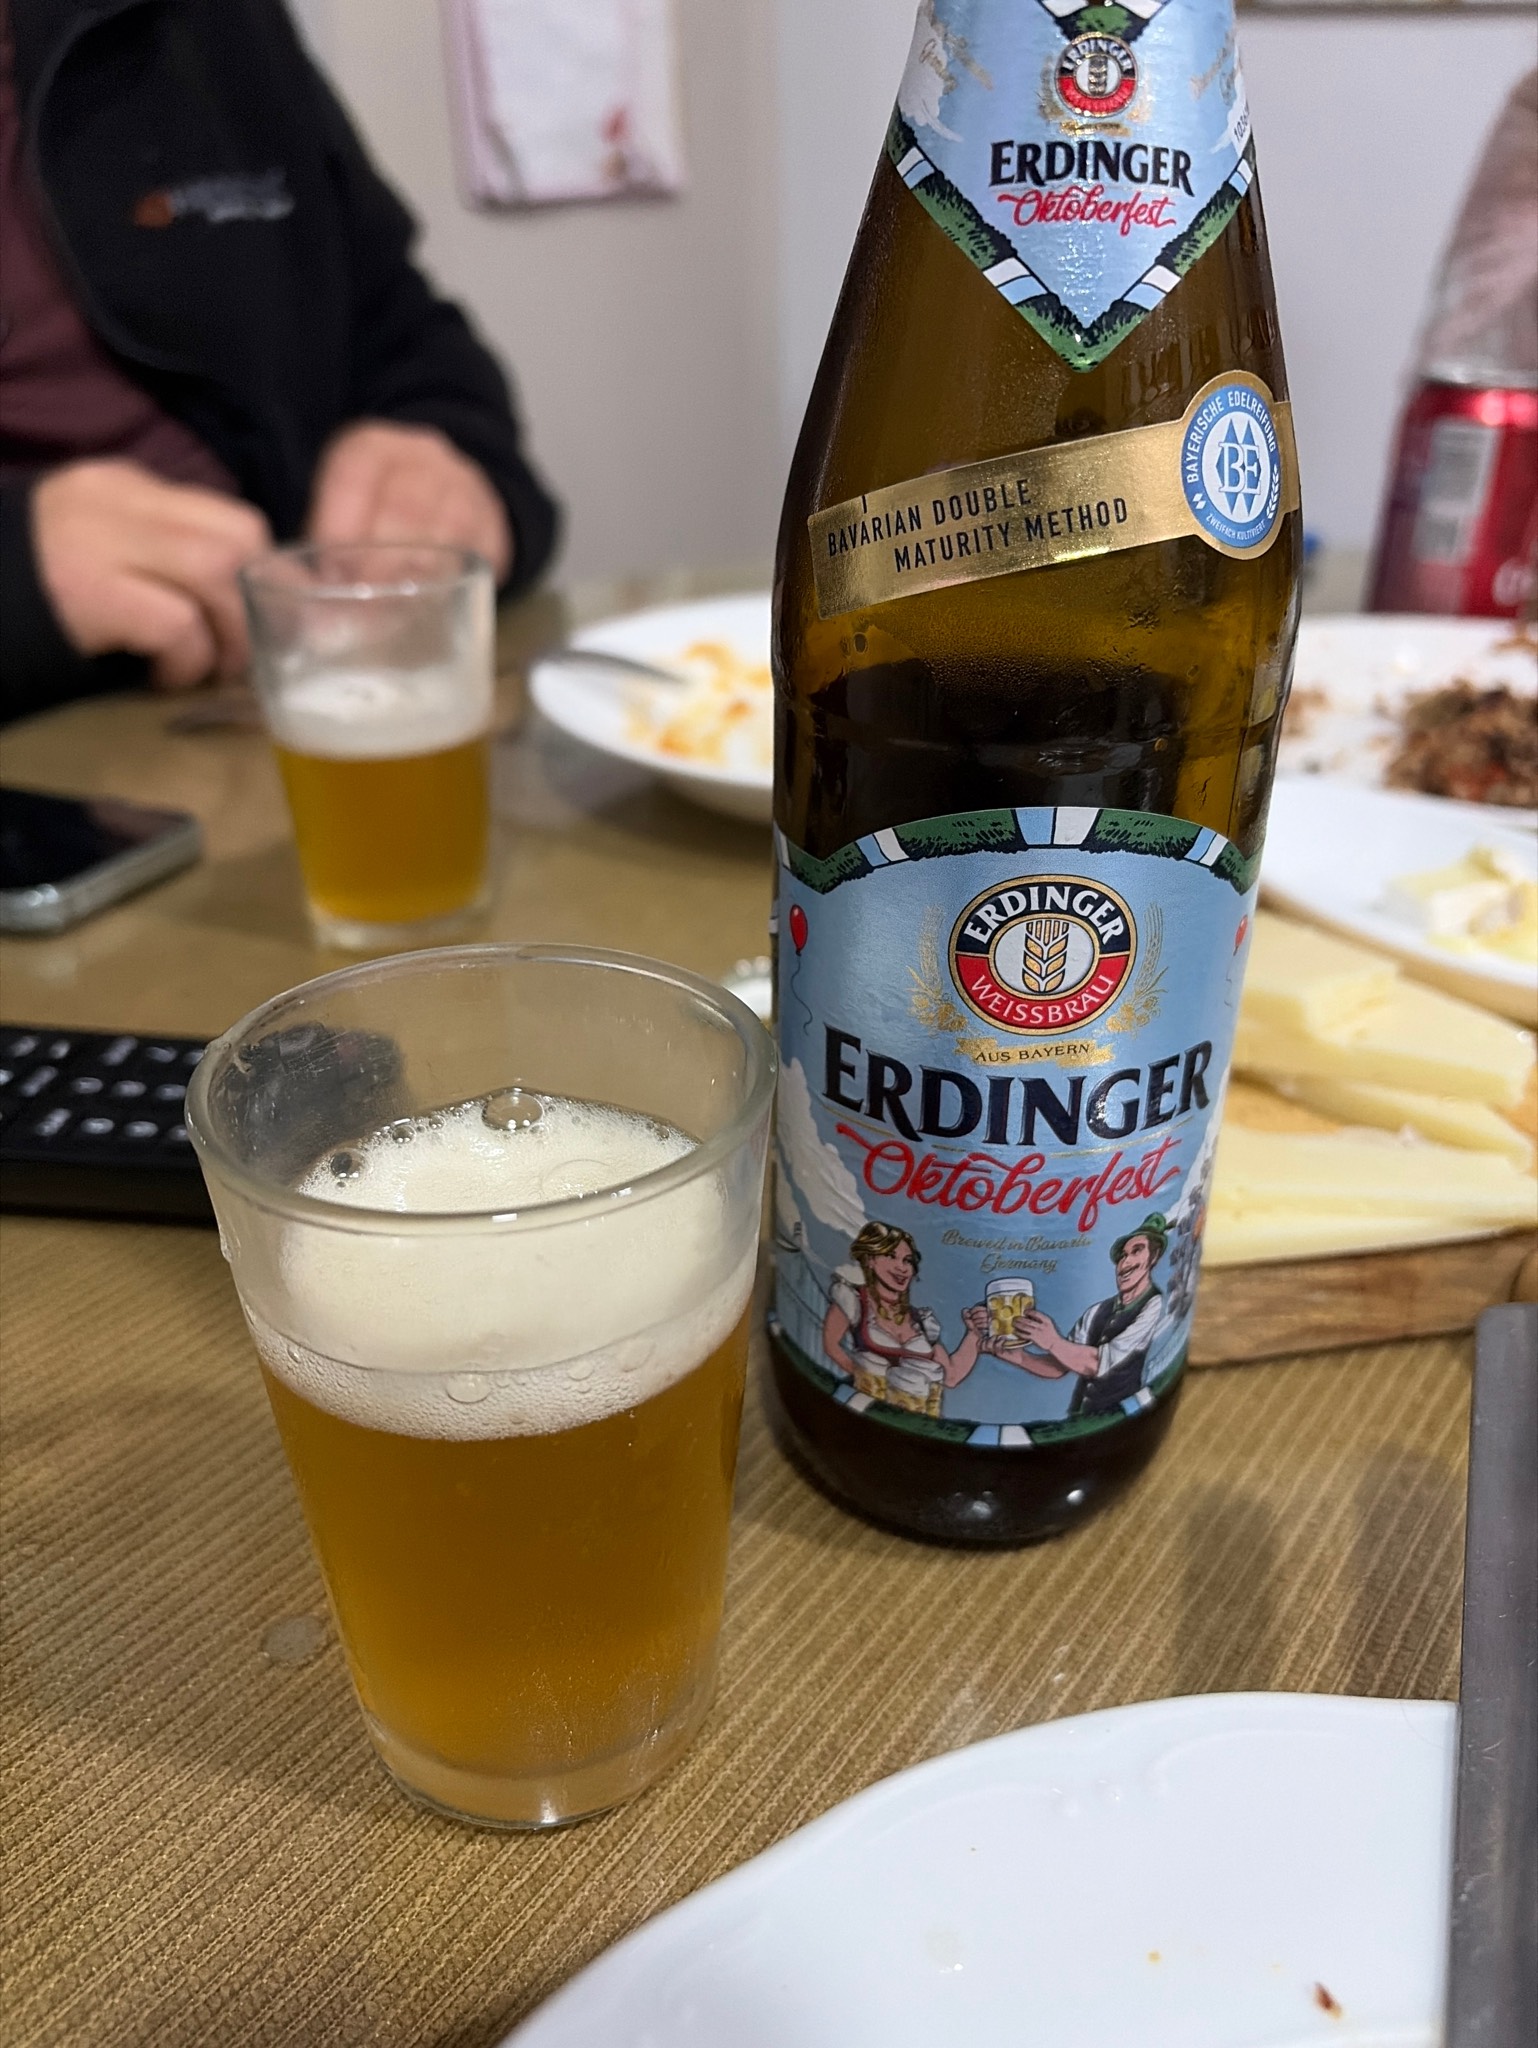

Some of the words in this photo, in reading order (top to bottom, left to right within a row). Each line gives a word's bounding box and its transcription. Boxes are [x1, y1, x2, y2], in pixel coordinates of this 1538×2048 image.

[1062, 39, 1133, 71] ERDINGER
[989, 140, 1196, 197] ERDINGER
[997, 184, 1177, 236] Oktoberfest
[1186, 396, 1225, 484] BAYERISCHE
[1227, 390, 1277, 453] EDELREIFUNG
[1218, 442, 1262, 495] BE
[827, 505, 922, 557] BAVARIAN
[932, 479, 1032, 525] DOUBLE
[894, 521, 1011, 573] MATURITY
[1024, 497, 1128, 542] METHOD
[1205, 512, 1236, 539] ZWEIFACH
[963, 885, 1125, 945] ERDINGER
[971, 974, 1115, 1025] WEISSBRÄU
[974, 1051, 1011, 1063] AUS
[1018, 1043, 1090, 1061] BAYERN
[821, 1024, 1213, 1146] ERDINGER
[835, 1122, 1182, 1232] Oktoberfest
[941, 1228, 1006, 1250] Brewed
[1007, 1240, 1024, 1251] in
[980, 1252, 1058, 1274] Germany
